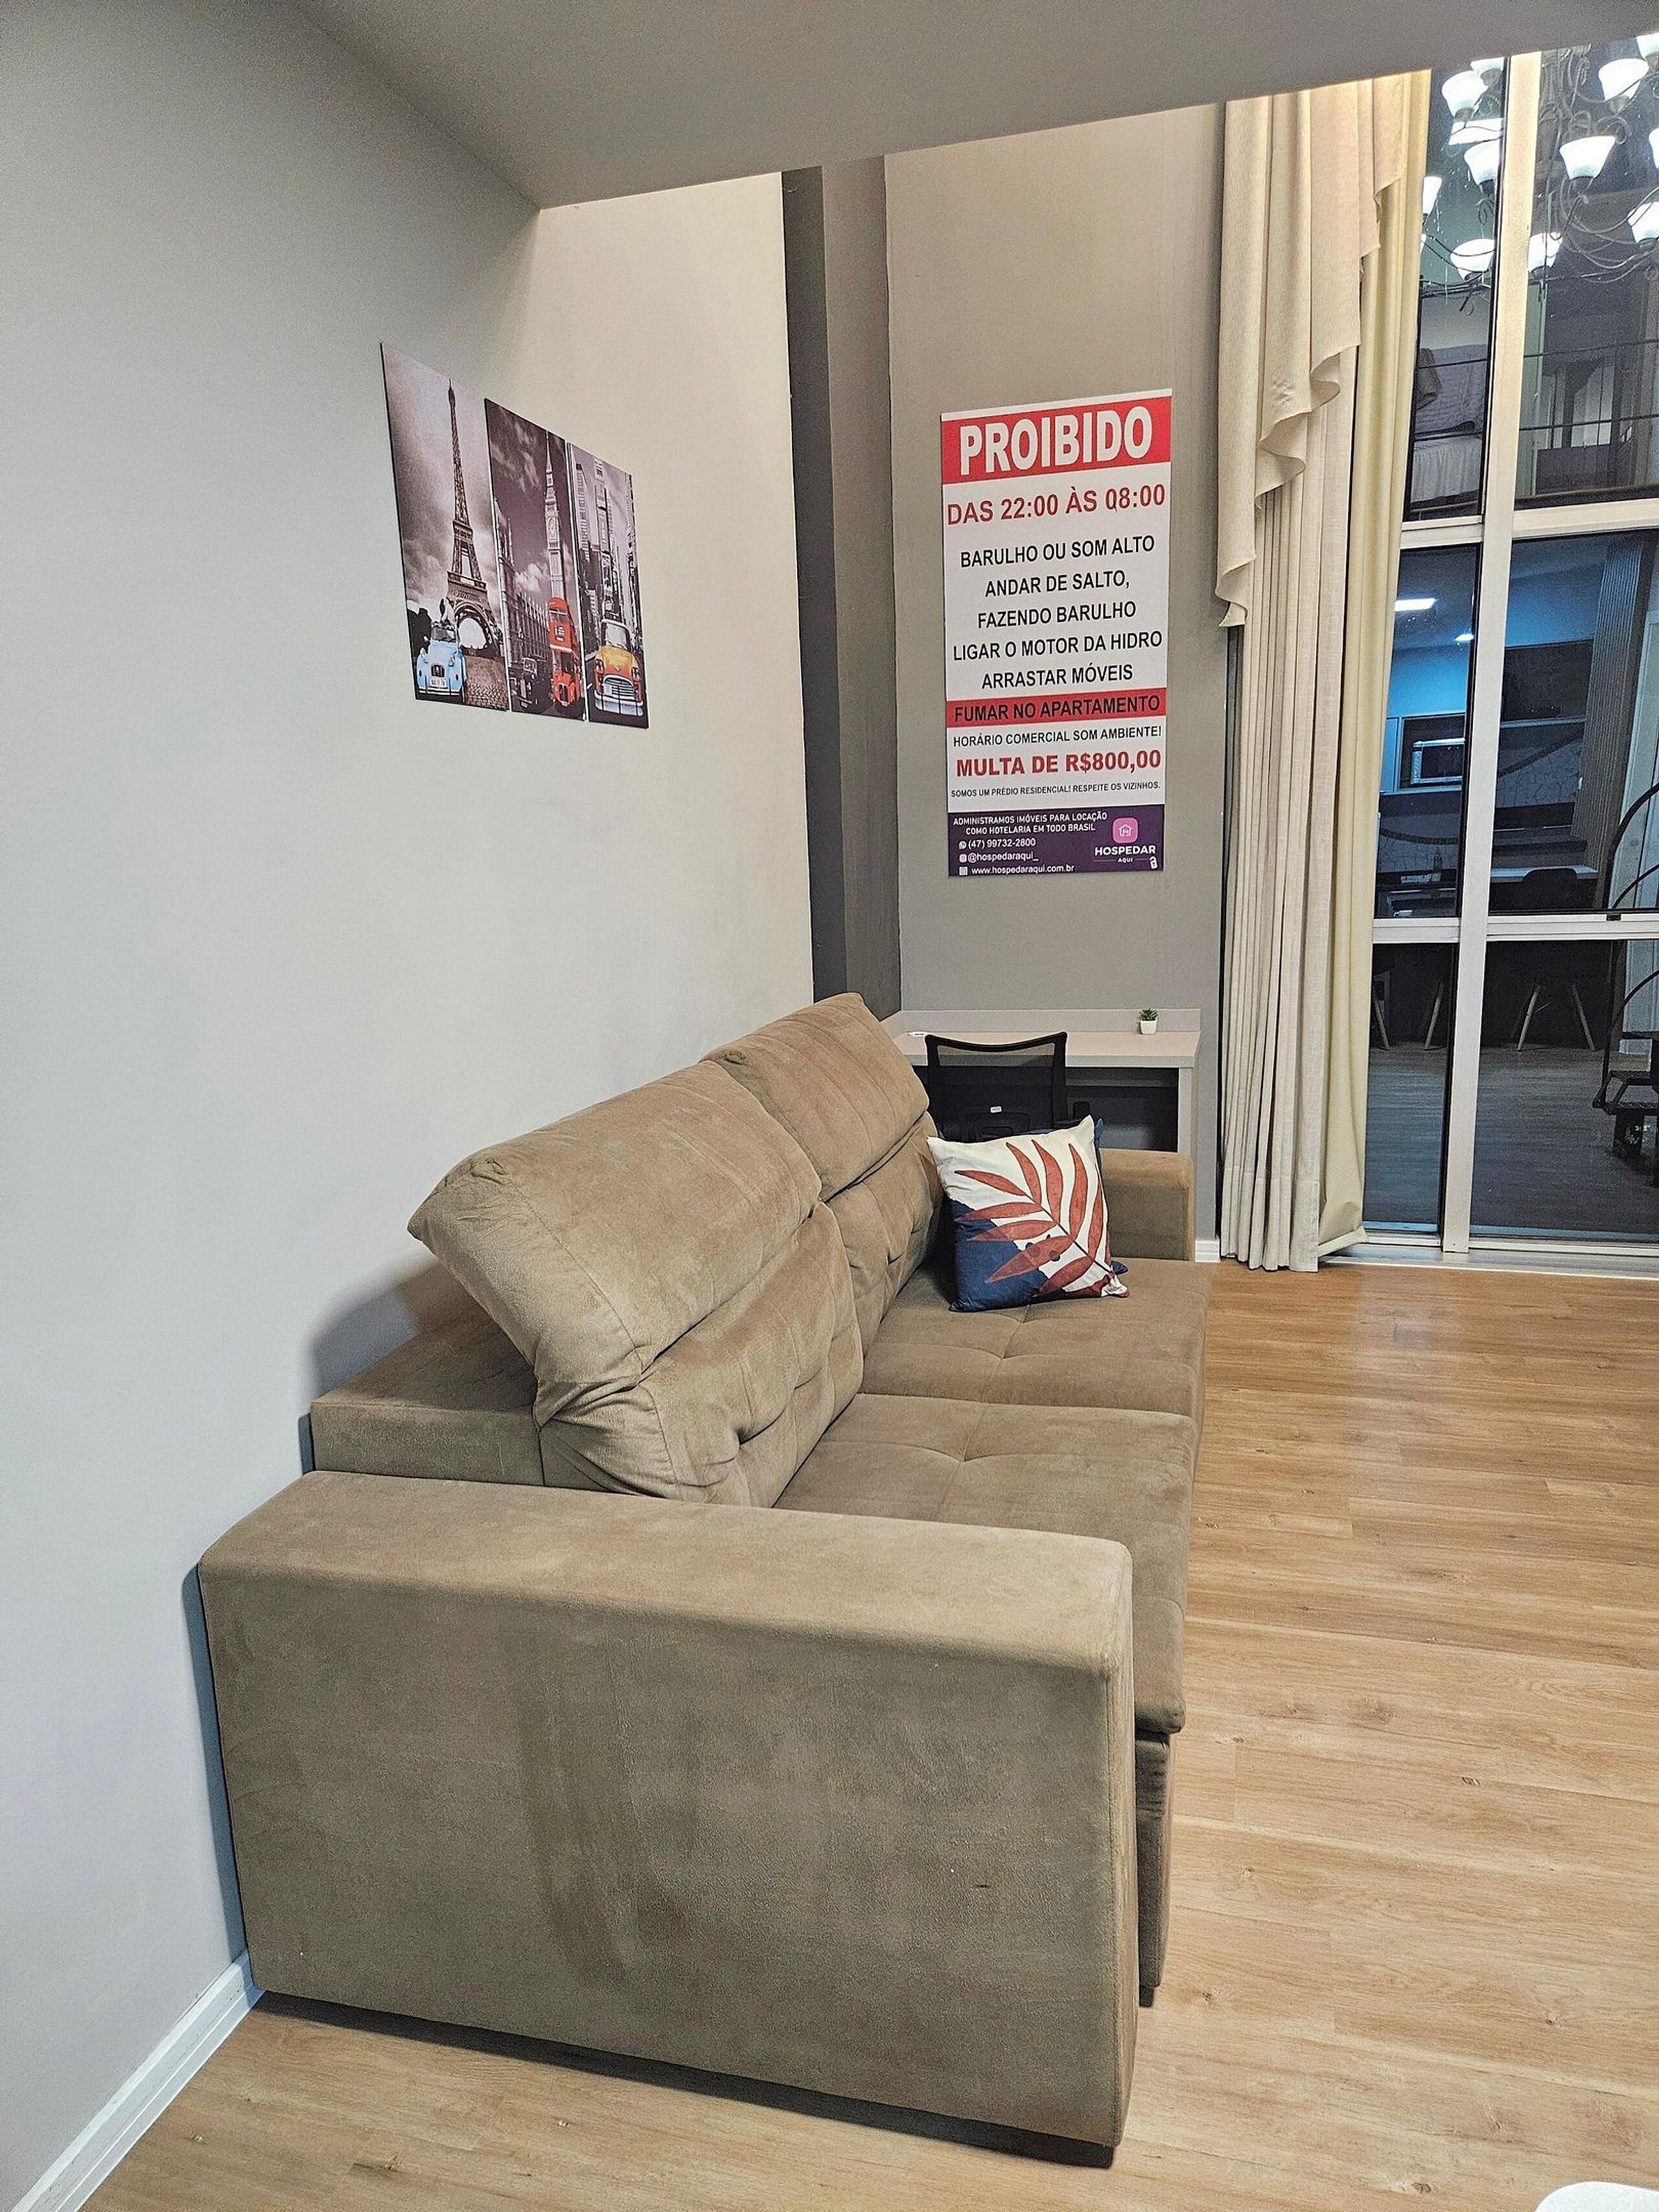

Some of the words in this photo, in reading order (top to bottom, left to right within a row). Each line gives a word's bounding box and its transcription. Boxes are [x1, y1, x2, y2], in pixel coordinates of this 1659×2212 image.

[960, 406, 1152, 476] PROIBIDO
[948, 500, 993, 525] DAS
[1001, 494, 1058, 519] 22:00
[1065, 486, 1097, 514] ÀS
[1106, 483, 1165, 511] 08:00
[961, 545, 1037, 567] BARULHO
[1043, 543, 1066, 560] OU
[1071, 539, 1107, 558] SOM
[1111, 535, 1155, 554] ALTO
[985, 576, 1041, 597] ANDAR
[1047, 574, 1067, 592] DE
[1073, 570, 1130, 590] SALTO,
[978, 607, 1051, 629] FAZENDO
[1057, 601, 1136, 623] BARULHO
[953, 643, 1000, 660] LIGAR
[1005, 642, 1016, 657] O
[1022, 637, 1078, 657] MOTOR
[1084, 635, 1106, 652] DA
[1111, 631, 1162, 650] HIDRO
[982, 669, 1066, 689] ARRASTAR
[1072, 662, 1133, 683] MÓVEIS
[955, 704, 1008, 722] FUMAR
[1014, 703, 1036, 719] NO
[1040, 695, 1160, 717] APARTAMENTO
[953, 732, 1003, 747] HORÁRIO
[1006, 730, 1069, 745] COMERCIAL
[1073, 729, 1098, 741] SOM
[1100, 726, 1161, 739] AMBIENTE!
[957, 757, 1025, 777] MULTA
[1032, 755, 1058, 774] DE
[1066, 749, 1161, 773] R$800,00
[951, 789, 977, 798] SOMOS
[992, 787, 1018, 796] PRÉDIO
[1021, 785, 1071, 795] RESIDENCIAL!
[1073, 784, 1108, 793] RESPEITE
[1123, 782, 1160, 790] VIZINHOS.
[953, 816, 1014, 826] ADMINISTRAMOS
[1017, 813, 1047, 823] IMÓVEIS
[1072, 811, 1108, 821] LOCAÇÃO
[989, 826, 1030, 834] HOTELARIA
[1068, 823, 1095, 832] BRASIL
[968, 840, 985, 850] (47)
[987, 838, 1036, 847] 99732-2800
[968, 851, 1039, 863] @hospedaraqui_
[1095, 845, 1156, 856] HOSPEDAR
[972, 865, 1074, 875] www.hospedaraqui.com.br
